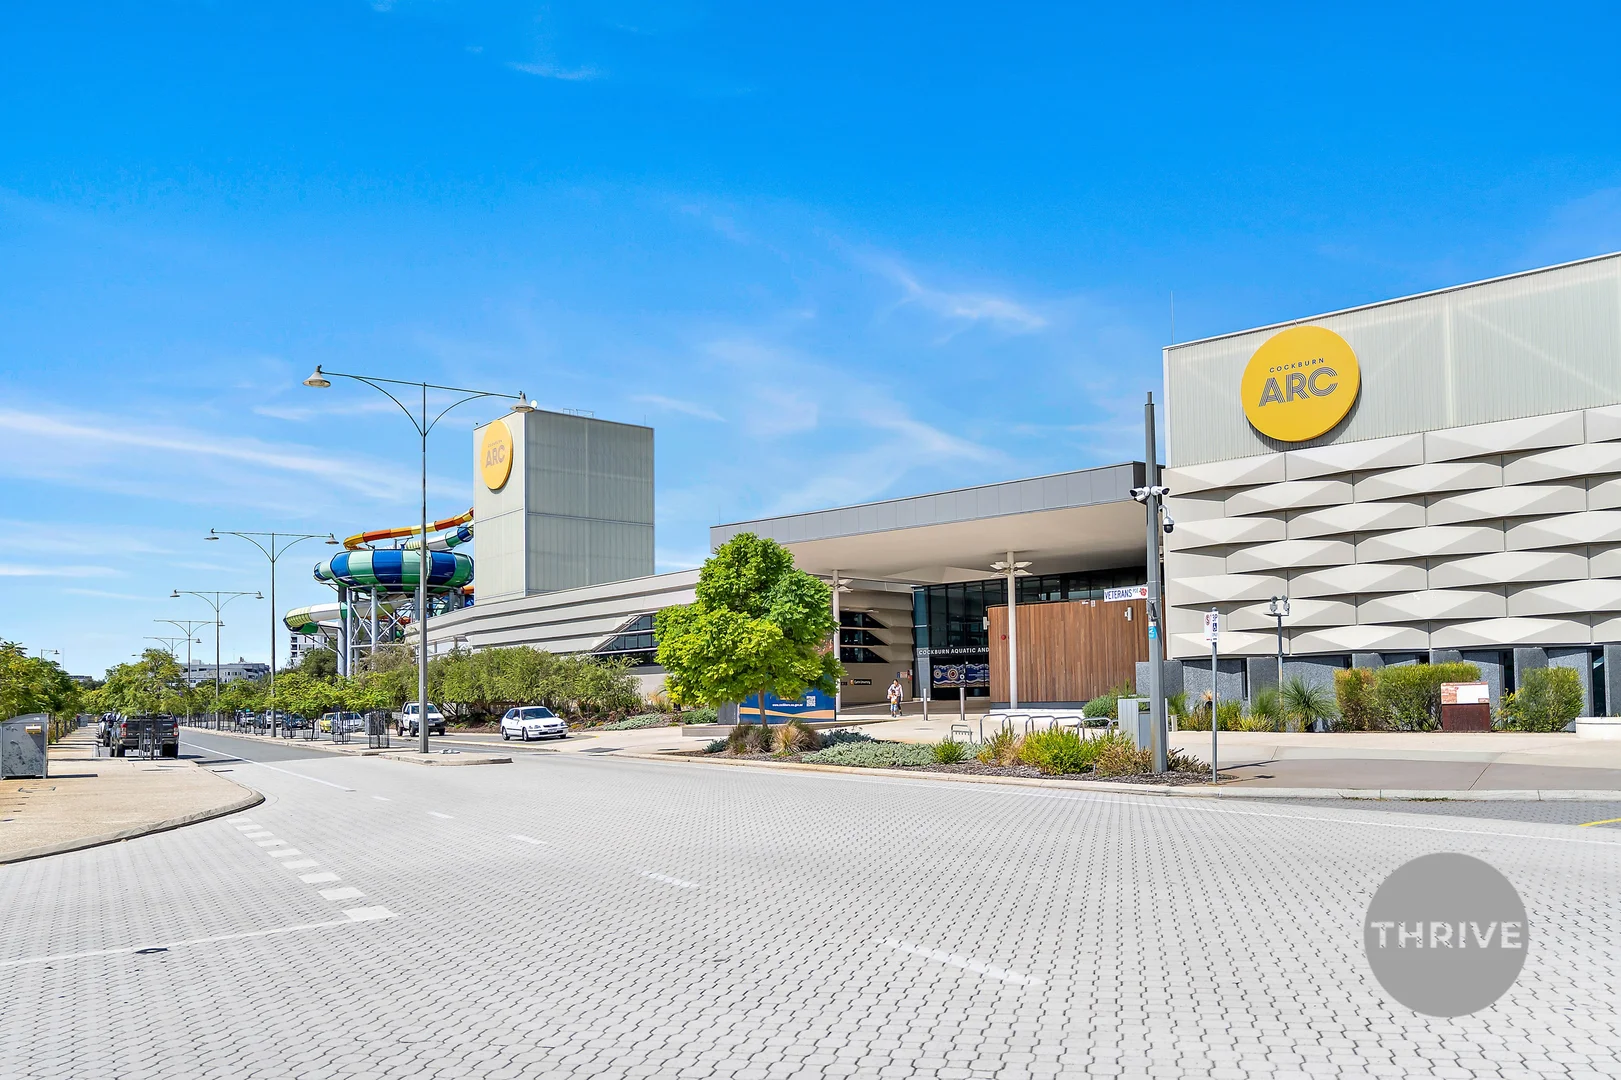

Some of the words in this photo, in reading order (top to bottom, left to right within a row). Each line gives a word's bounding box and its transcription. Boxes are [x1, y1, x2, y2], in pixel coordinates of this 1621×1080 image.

[1269, 358, 1324, 373] COCKBURN
[1258, 366, 1338, 407] ARC
[485, 444, 505, 468] ARC
[1105, 588, 1132, 600] VETERANS
